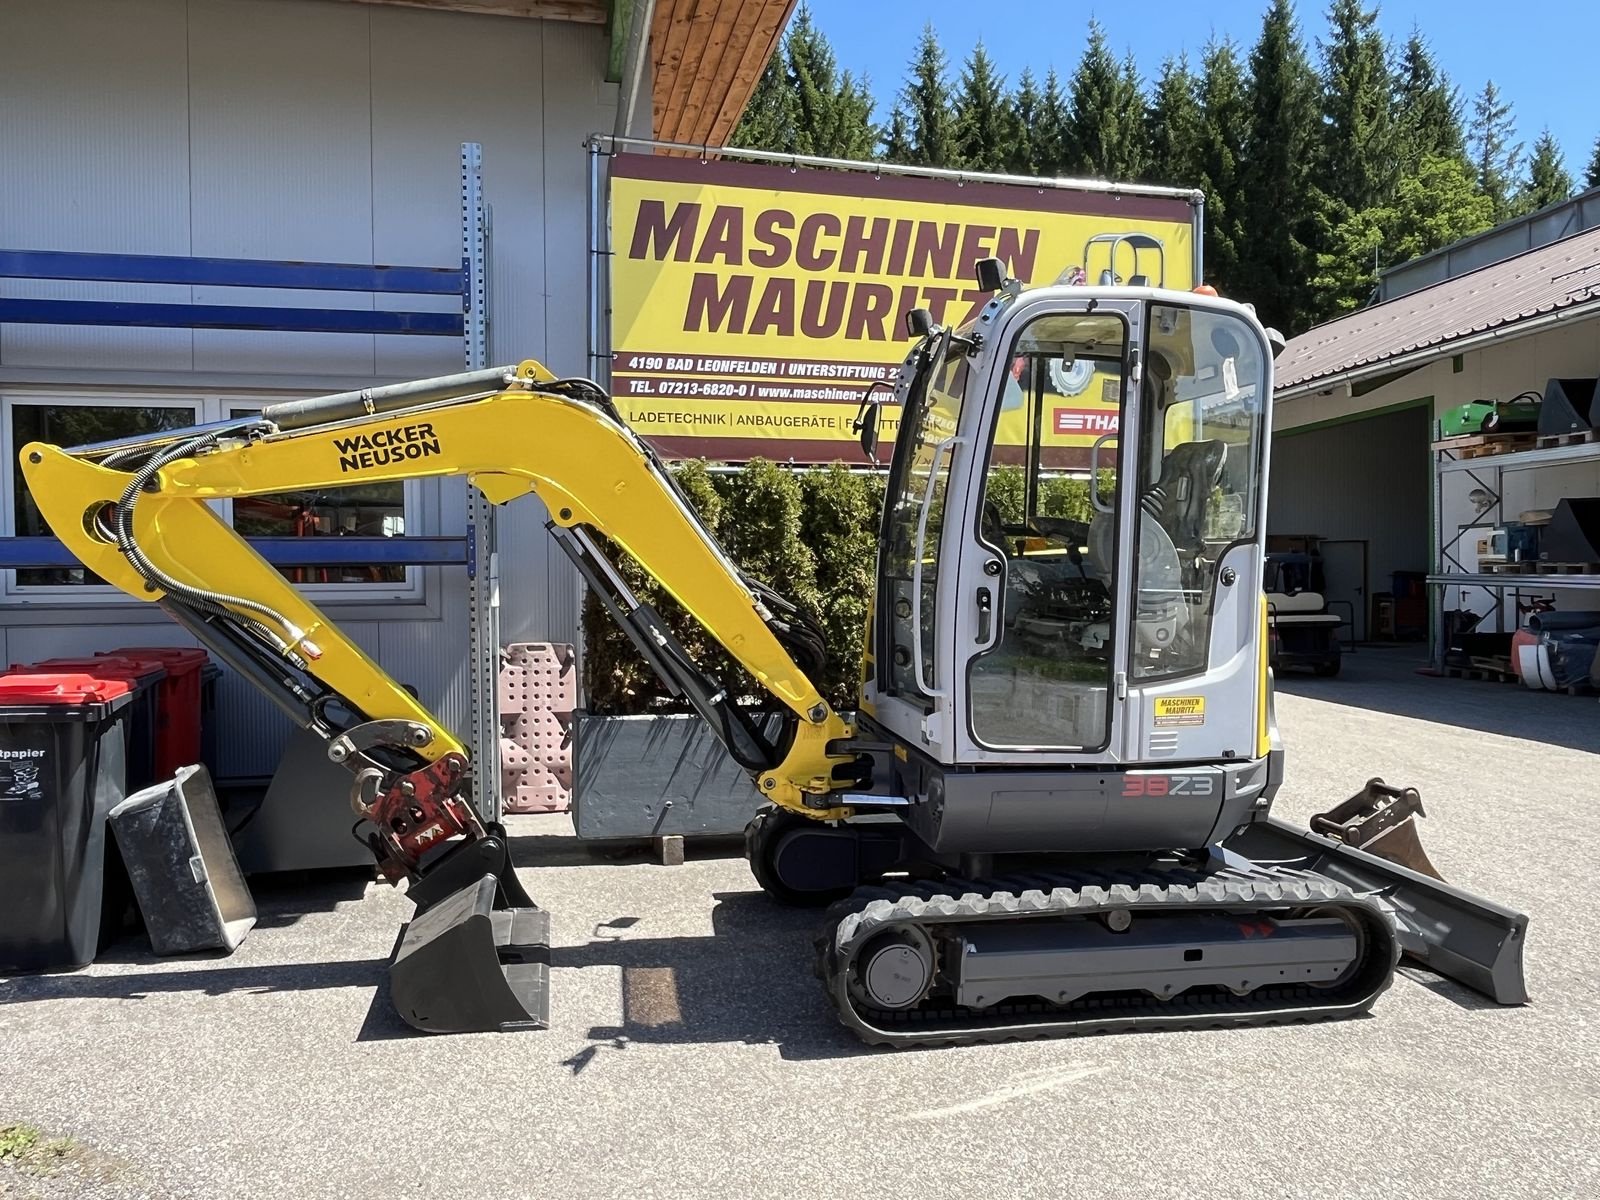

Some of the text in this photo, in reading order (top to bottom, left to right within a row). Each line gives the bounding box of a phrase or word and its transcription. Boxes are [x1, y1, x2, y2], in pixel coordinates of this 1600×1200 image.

[629, 199, 1040, 284] MASCHINEN
[628, 356, 663, 370] 4190
[665, 358, 693, 371] BAD
[696, 359, 777, 375] LEONFELDEN
[788, 363, 886, 379] UNTERSTIFTUNG
[629, 380, 655, 393] TEL.
[658, 381, 747, 396] 07213-6820-0
[629, 411, 726, 425] LADETECHNIK
[736, 414, 836, 428] ANBAUGERÄTE
[333, 423, 437, 454] WACKER
[339, 439, 441, 472] NEUSON
[1166, 706, 1195, 714] MAURITZ
